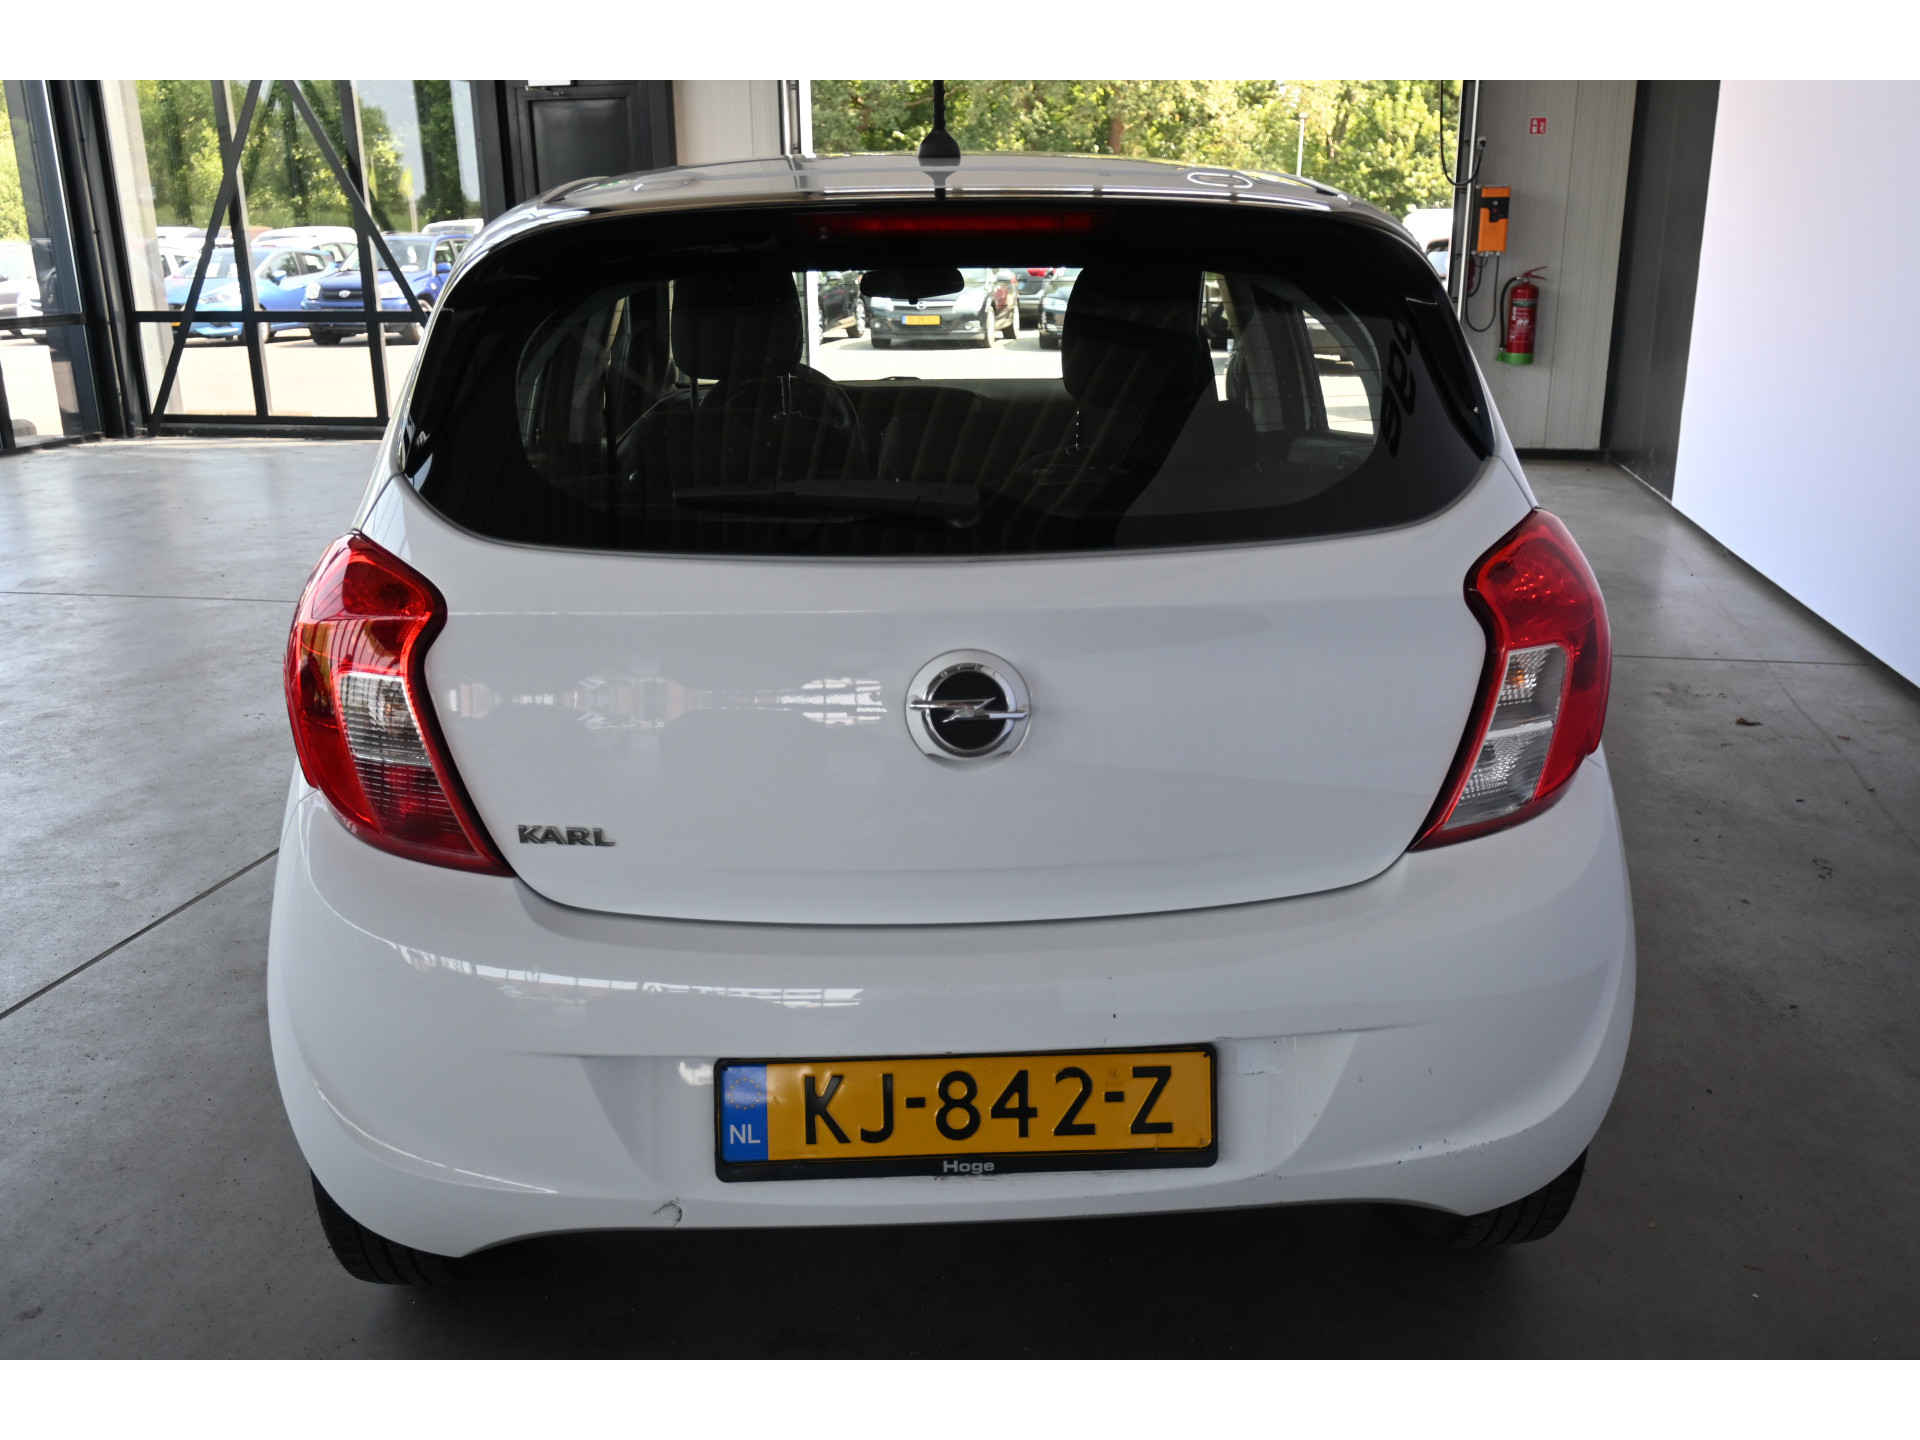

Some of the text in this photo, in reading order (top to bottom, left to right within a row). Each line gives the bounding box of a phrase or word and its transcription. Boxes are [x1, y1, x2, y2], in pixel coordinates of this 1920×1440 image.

[518, 825, 616, 846] KARL
[803, 1065, 1174, 1144] KJ-842-Z
[729, 1124, 761, 1144] NL
[943, 1160, 995, 1174] Hoge
